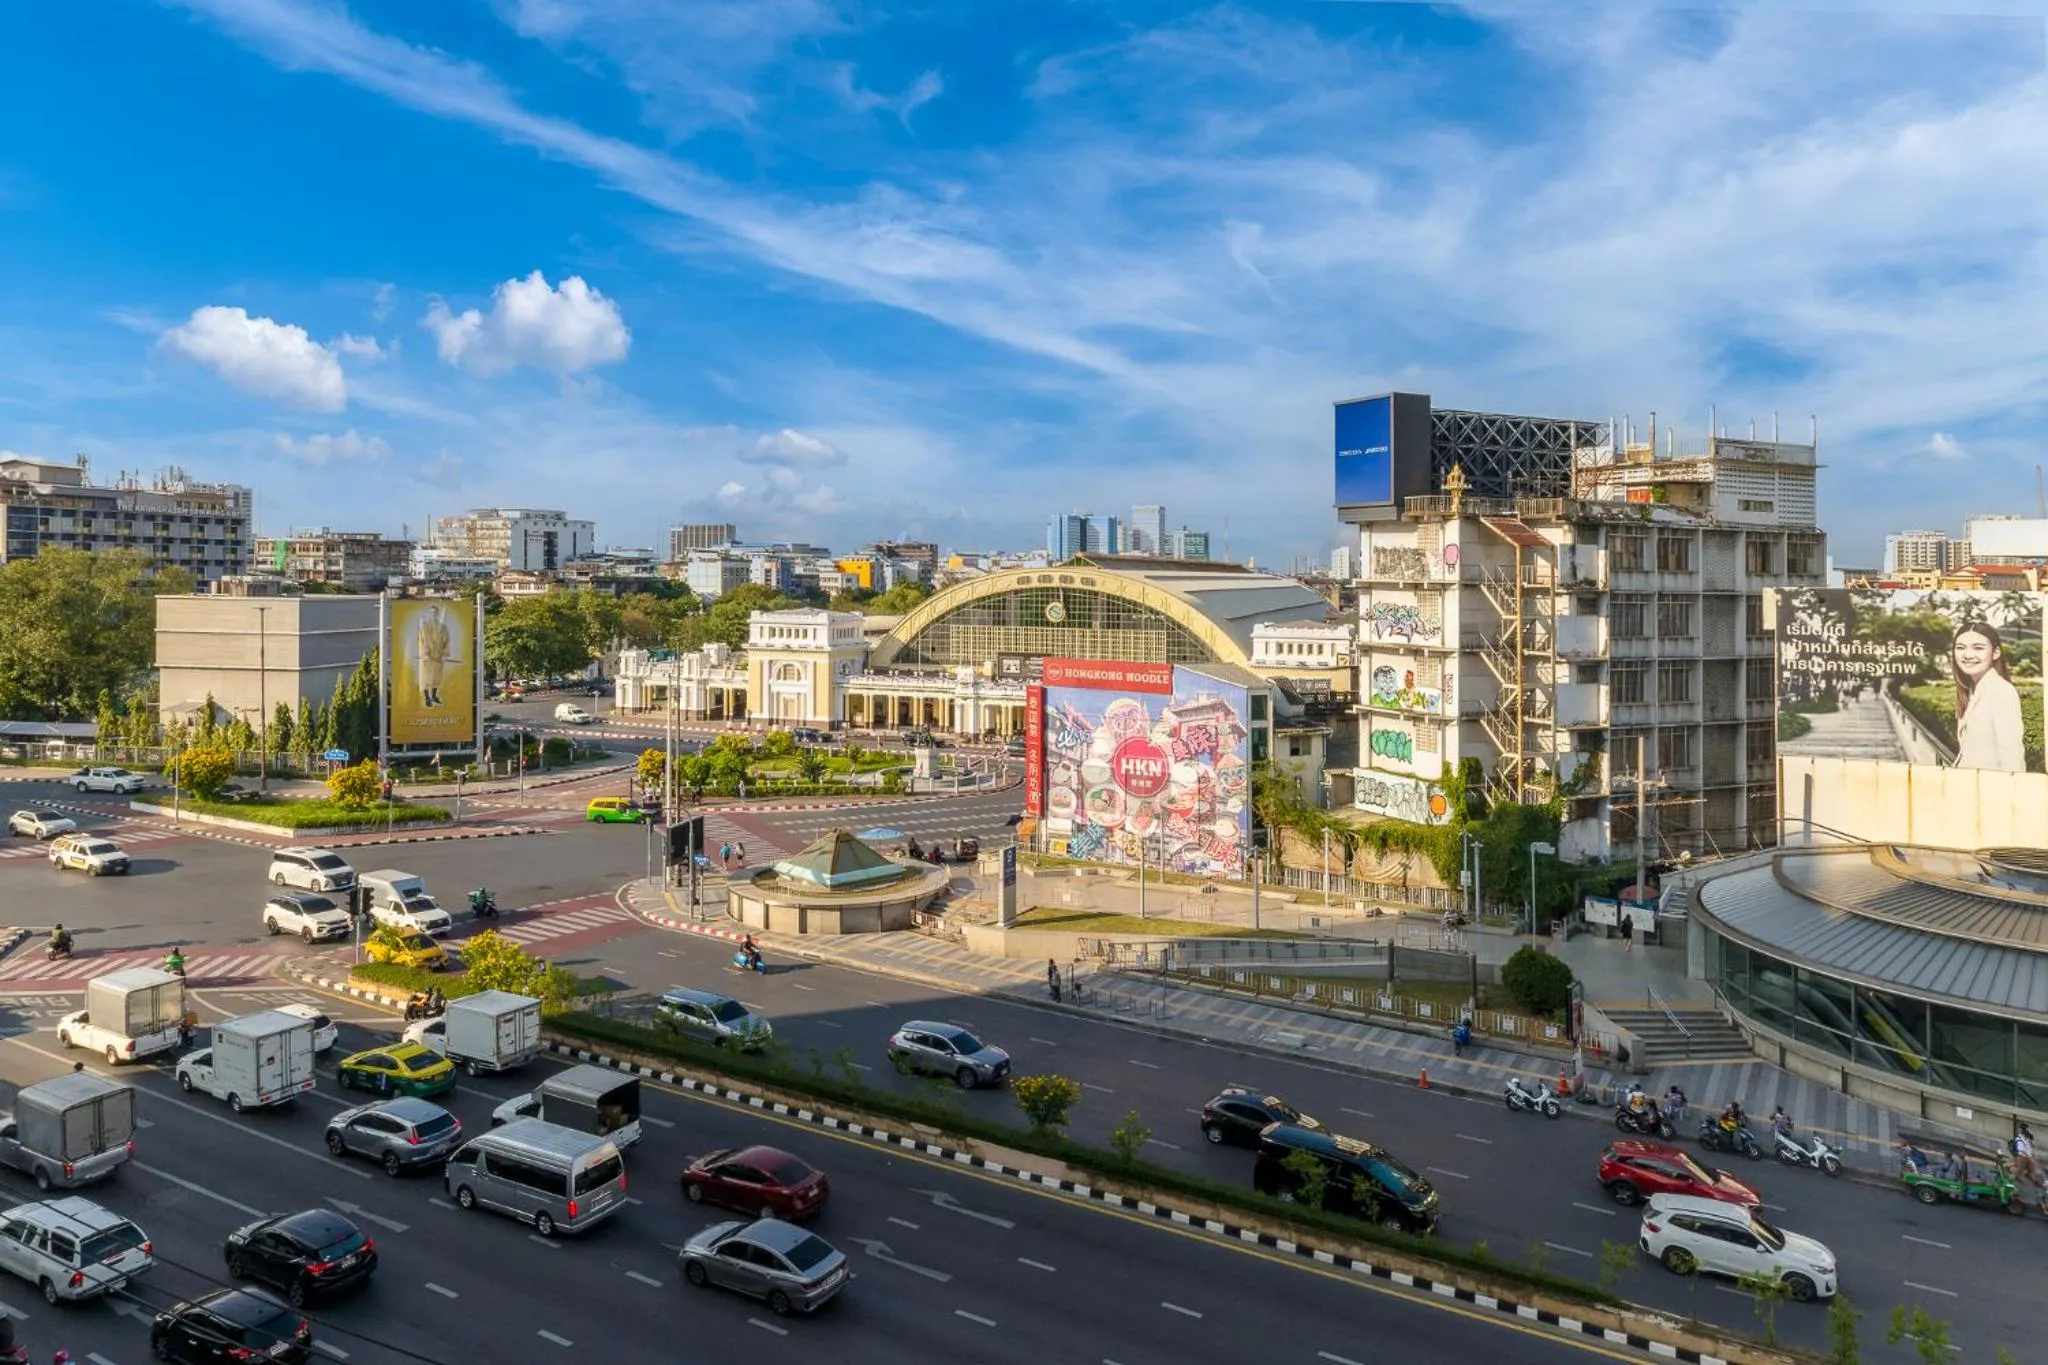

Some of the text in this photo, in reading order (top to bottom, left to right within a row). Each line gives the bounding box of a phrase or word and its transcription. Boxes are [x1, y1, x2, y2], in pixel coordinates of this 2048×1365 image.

[1064, 668, 1123, 681] HONGKONG
[1126, 672, 1170, 685] NOODLE
[1120, 757, 1163, 777] HKN
